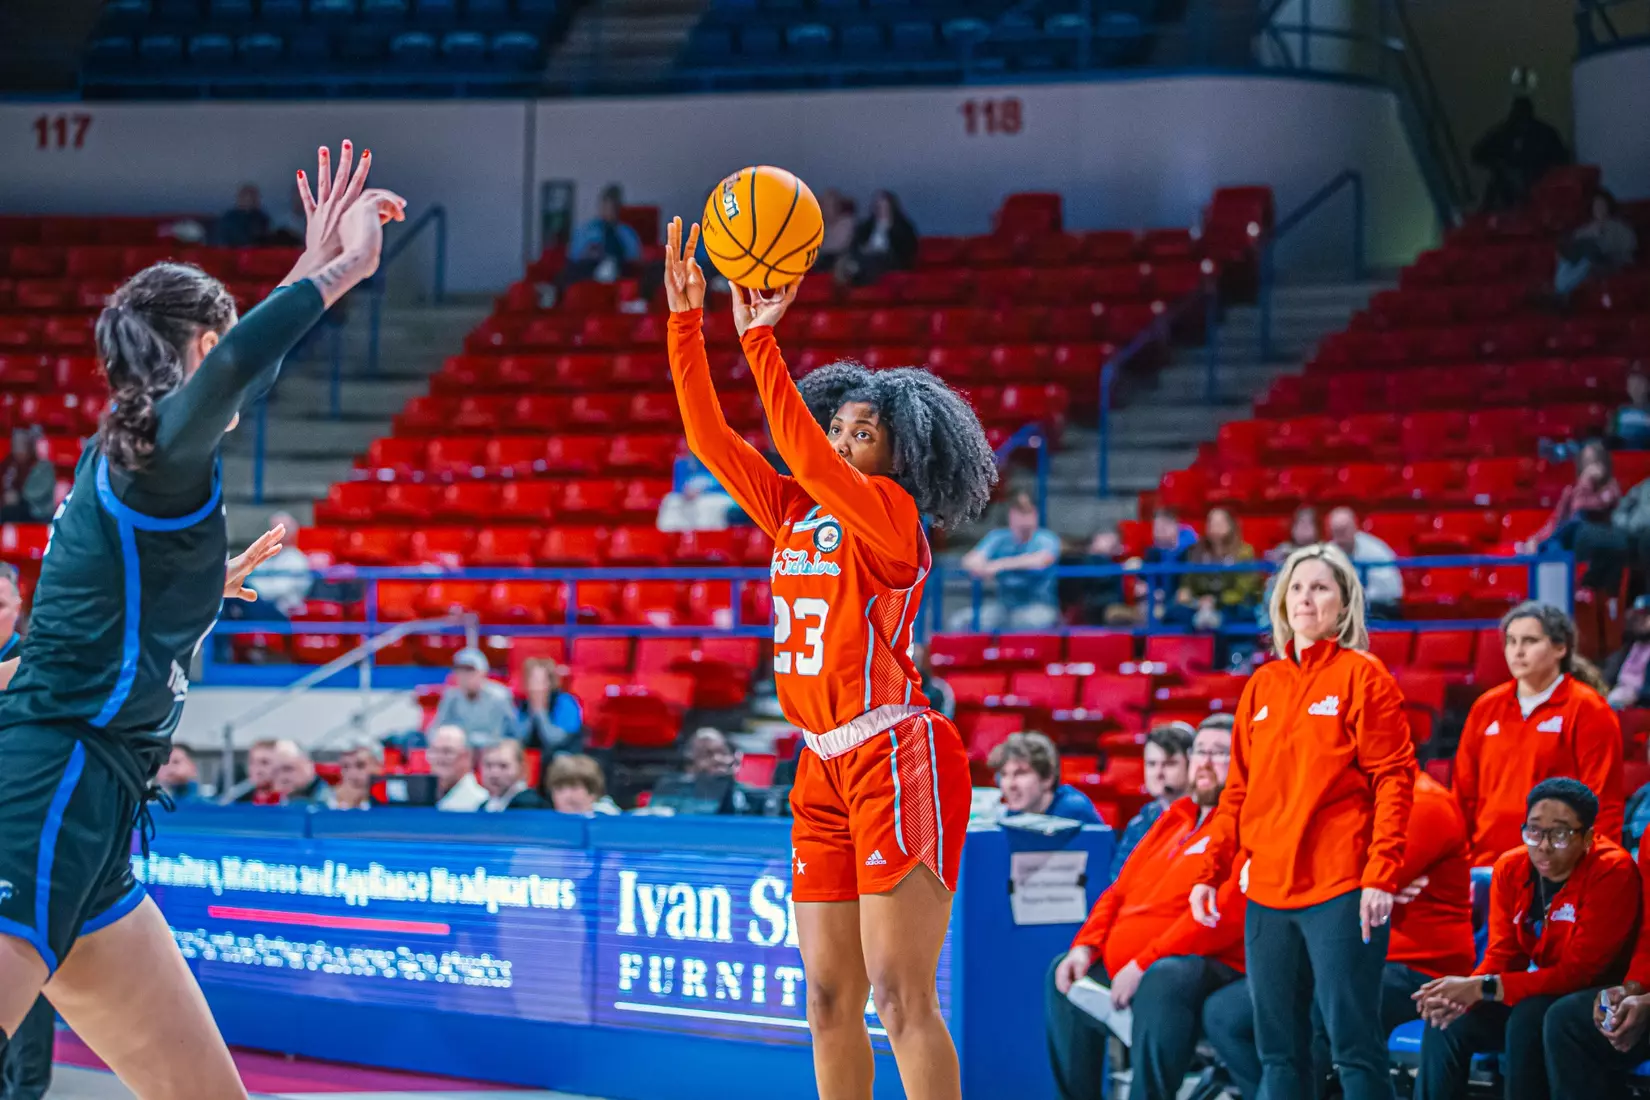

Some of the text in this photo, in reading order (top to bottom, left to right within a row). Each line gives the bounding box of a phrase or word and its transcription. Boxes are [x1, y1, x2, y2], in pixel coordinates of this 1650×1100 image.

[33, 112, 92, 149] 117
[958, 97, 1023, 136] 118
[773, 596, 829, 676] 23
[616, 870, 733, 943] Ivan
[618, 953, 805, 1006] FURNIT
